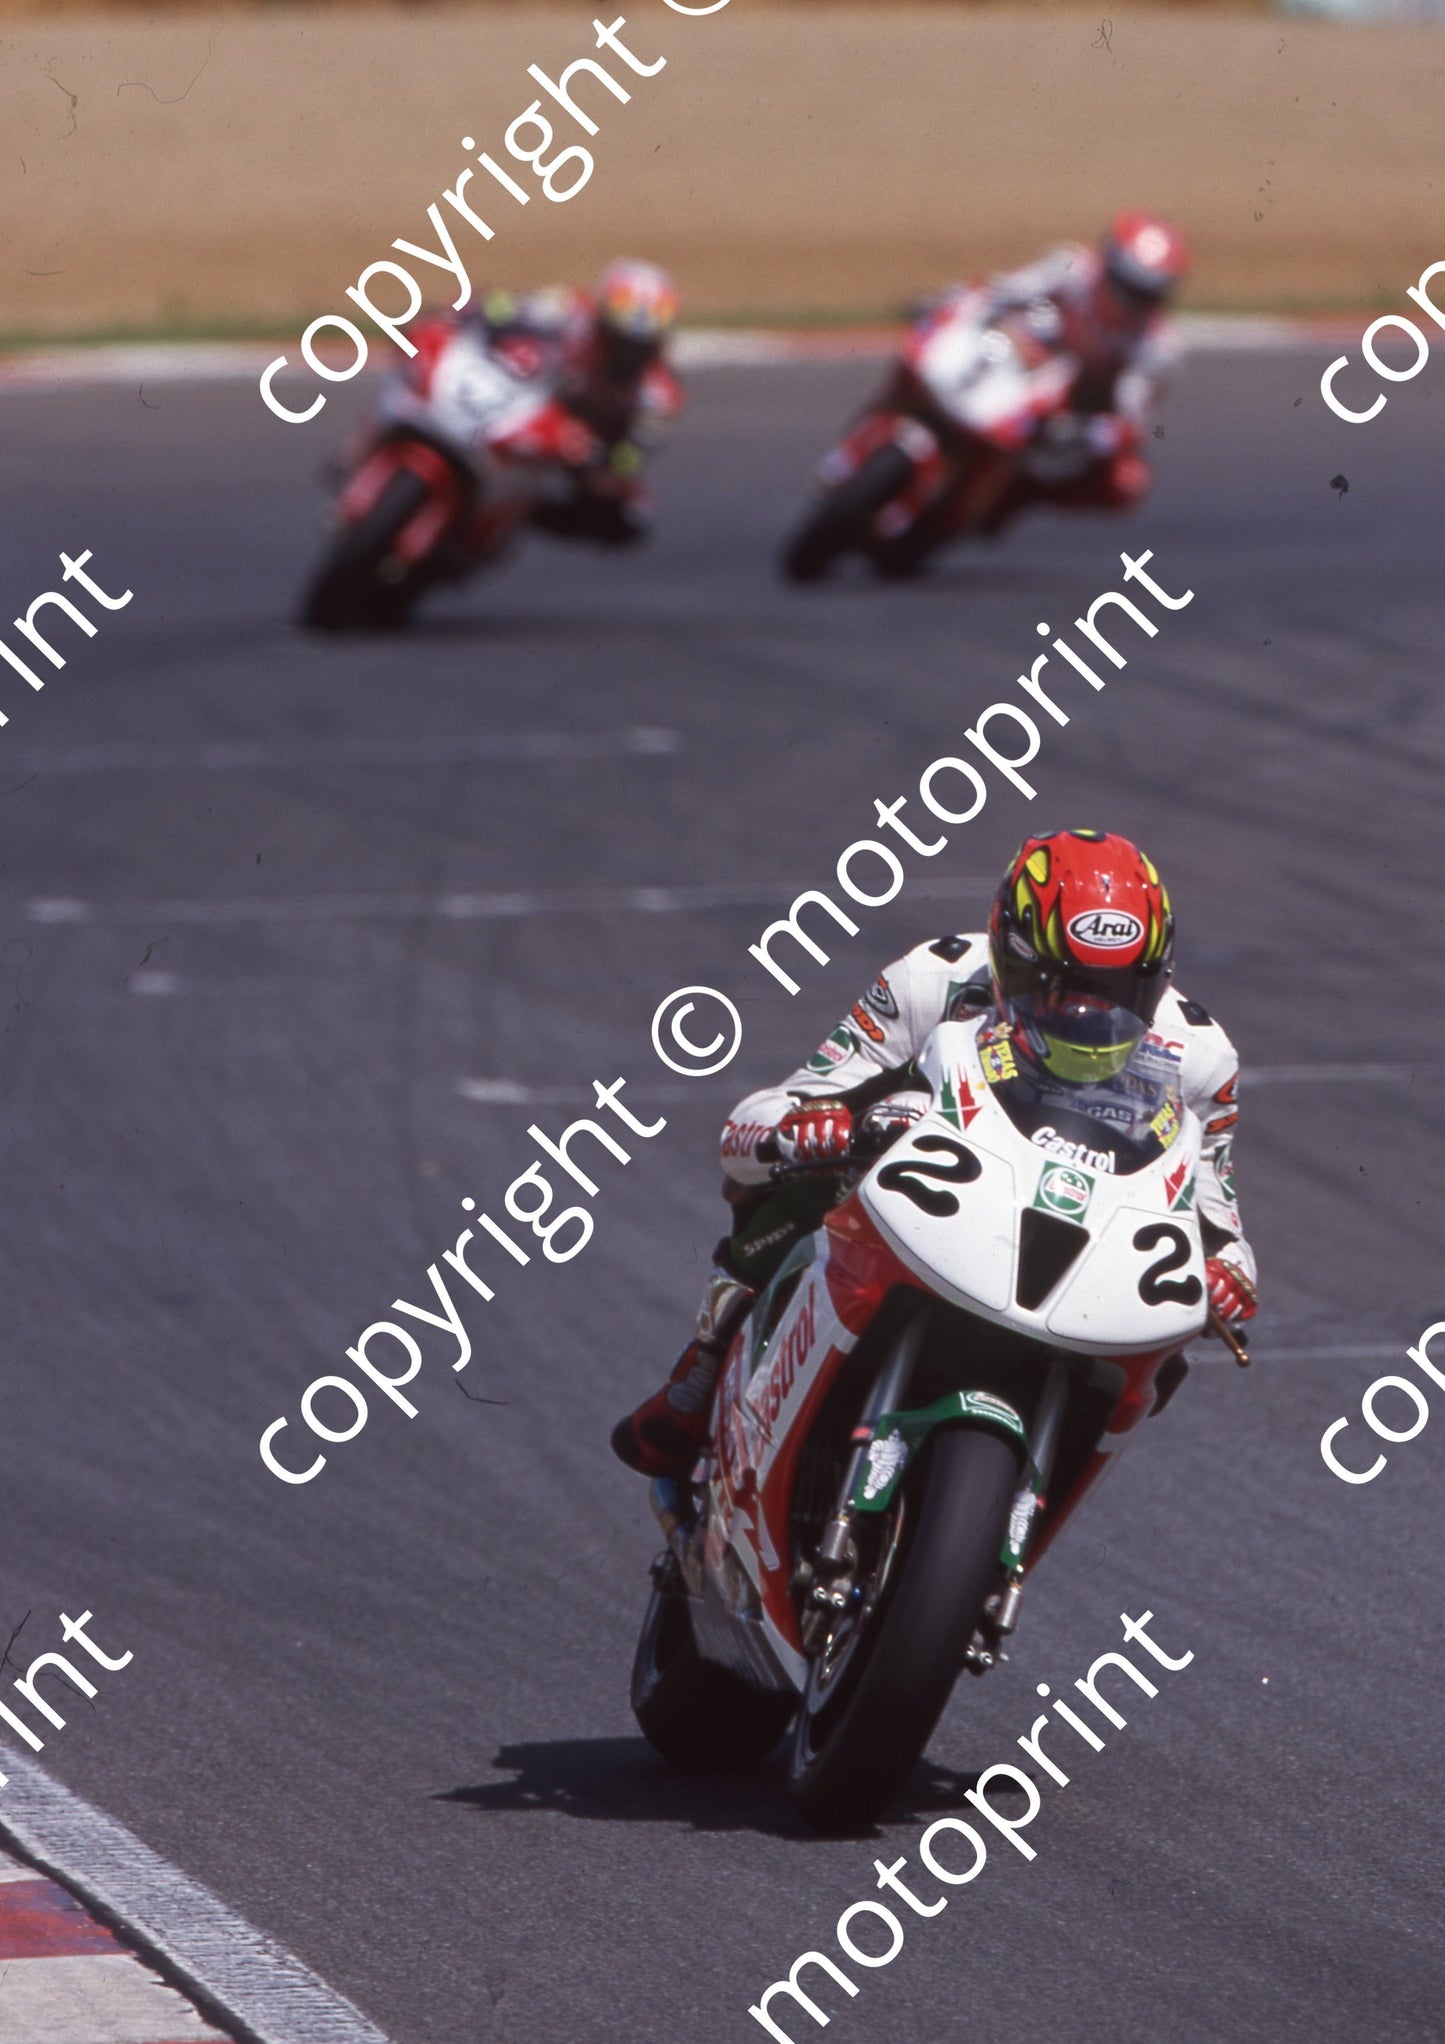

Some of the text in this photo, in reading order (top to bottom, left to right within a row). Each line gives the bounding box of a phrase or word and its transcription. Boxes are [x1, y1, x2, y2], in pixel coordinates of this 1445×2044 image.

[1076, 914, 1133, 936] Arai
[877, 1135, 982, 1217] 2
[1031, 1126, 1116, 1174] Castrol
[1133, 1222, 1203, 1306] 2
